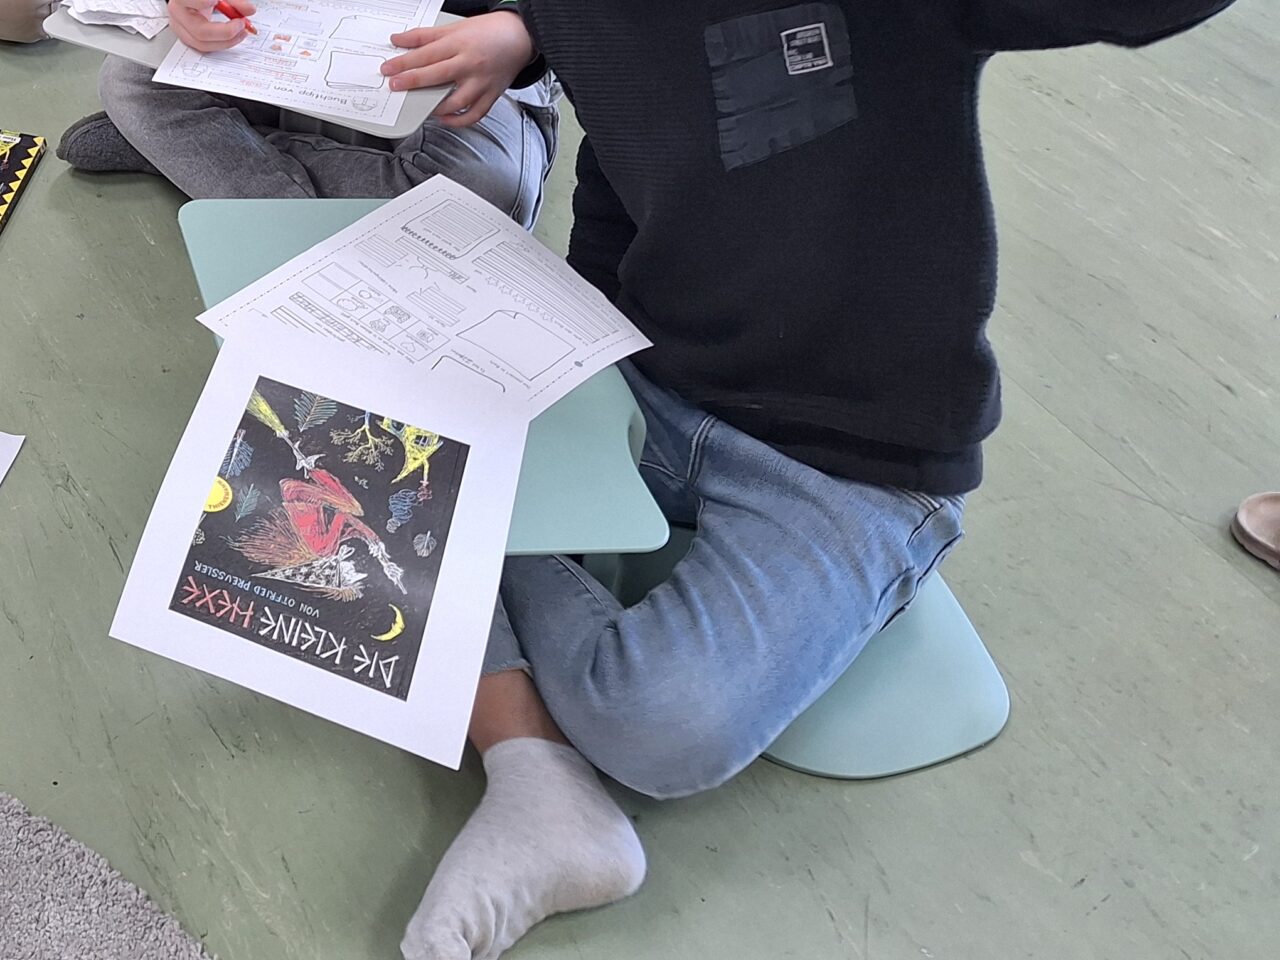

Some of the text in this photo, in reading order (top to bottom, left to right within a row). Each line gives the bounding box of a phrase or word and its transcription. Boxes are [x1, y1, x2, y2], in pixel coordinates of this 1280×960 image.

[272, 84, 347, 105] Buchtipp von
[253, 584, 297, 607] OTFRIED
[298, 603, 321, 618] VON
[180, 575, 400, 689] DIE KLEINE HEXE
